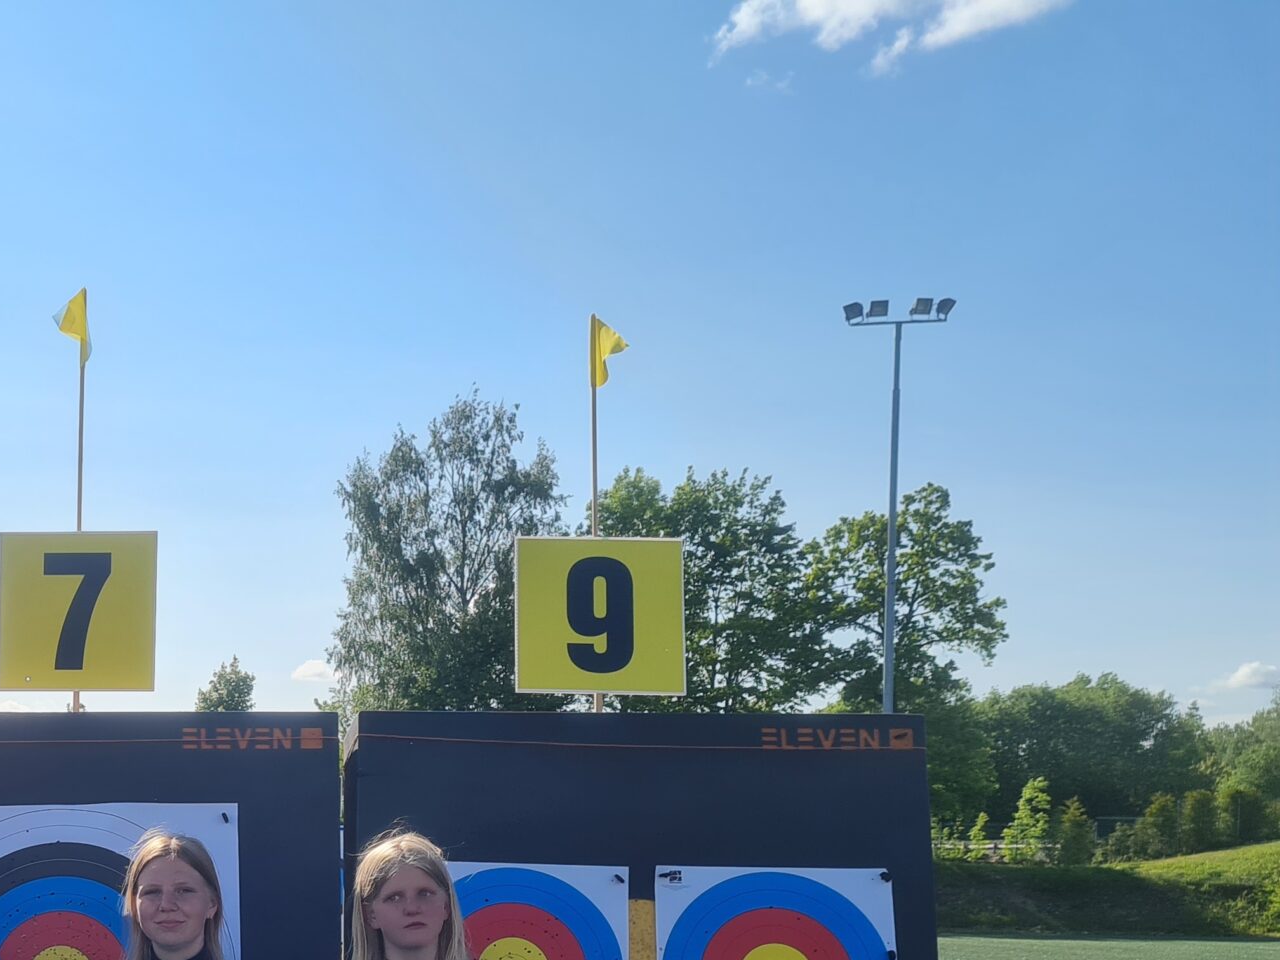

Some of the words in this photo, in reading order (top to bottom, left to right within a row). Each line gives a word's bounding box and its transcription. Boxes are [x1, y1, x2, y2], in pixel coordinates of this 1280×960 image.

[43, 552, 112, 671] 7
[566, 555, 634, 674] 9
[182, 727, 292, 750] ELEVEN
[761, 727, 880, 750] ELEVEN
